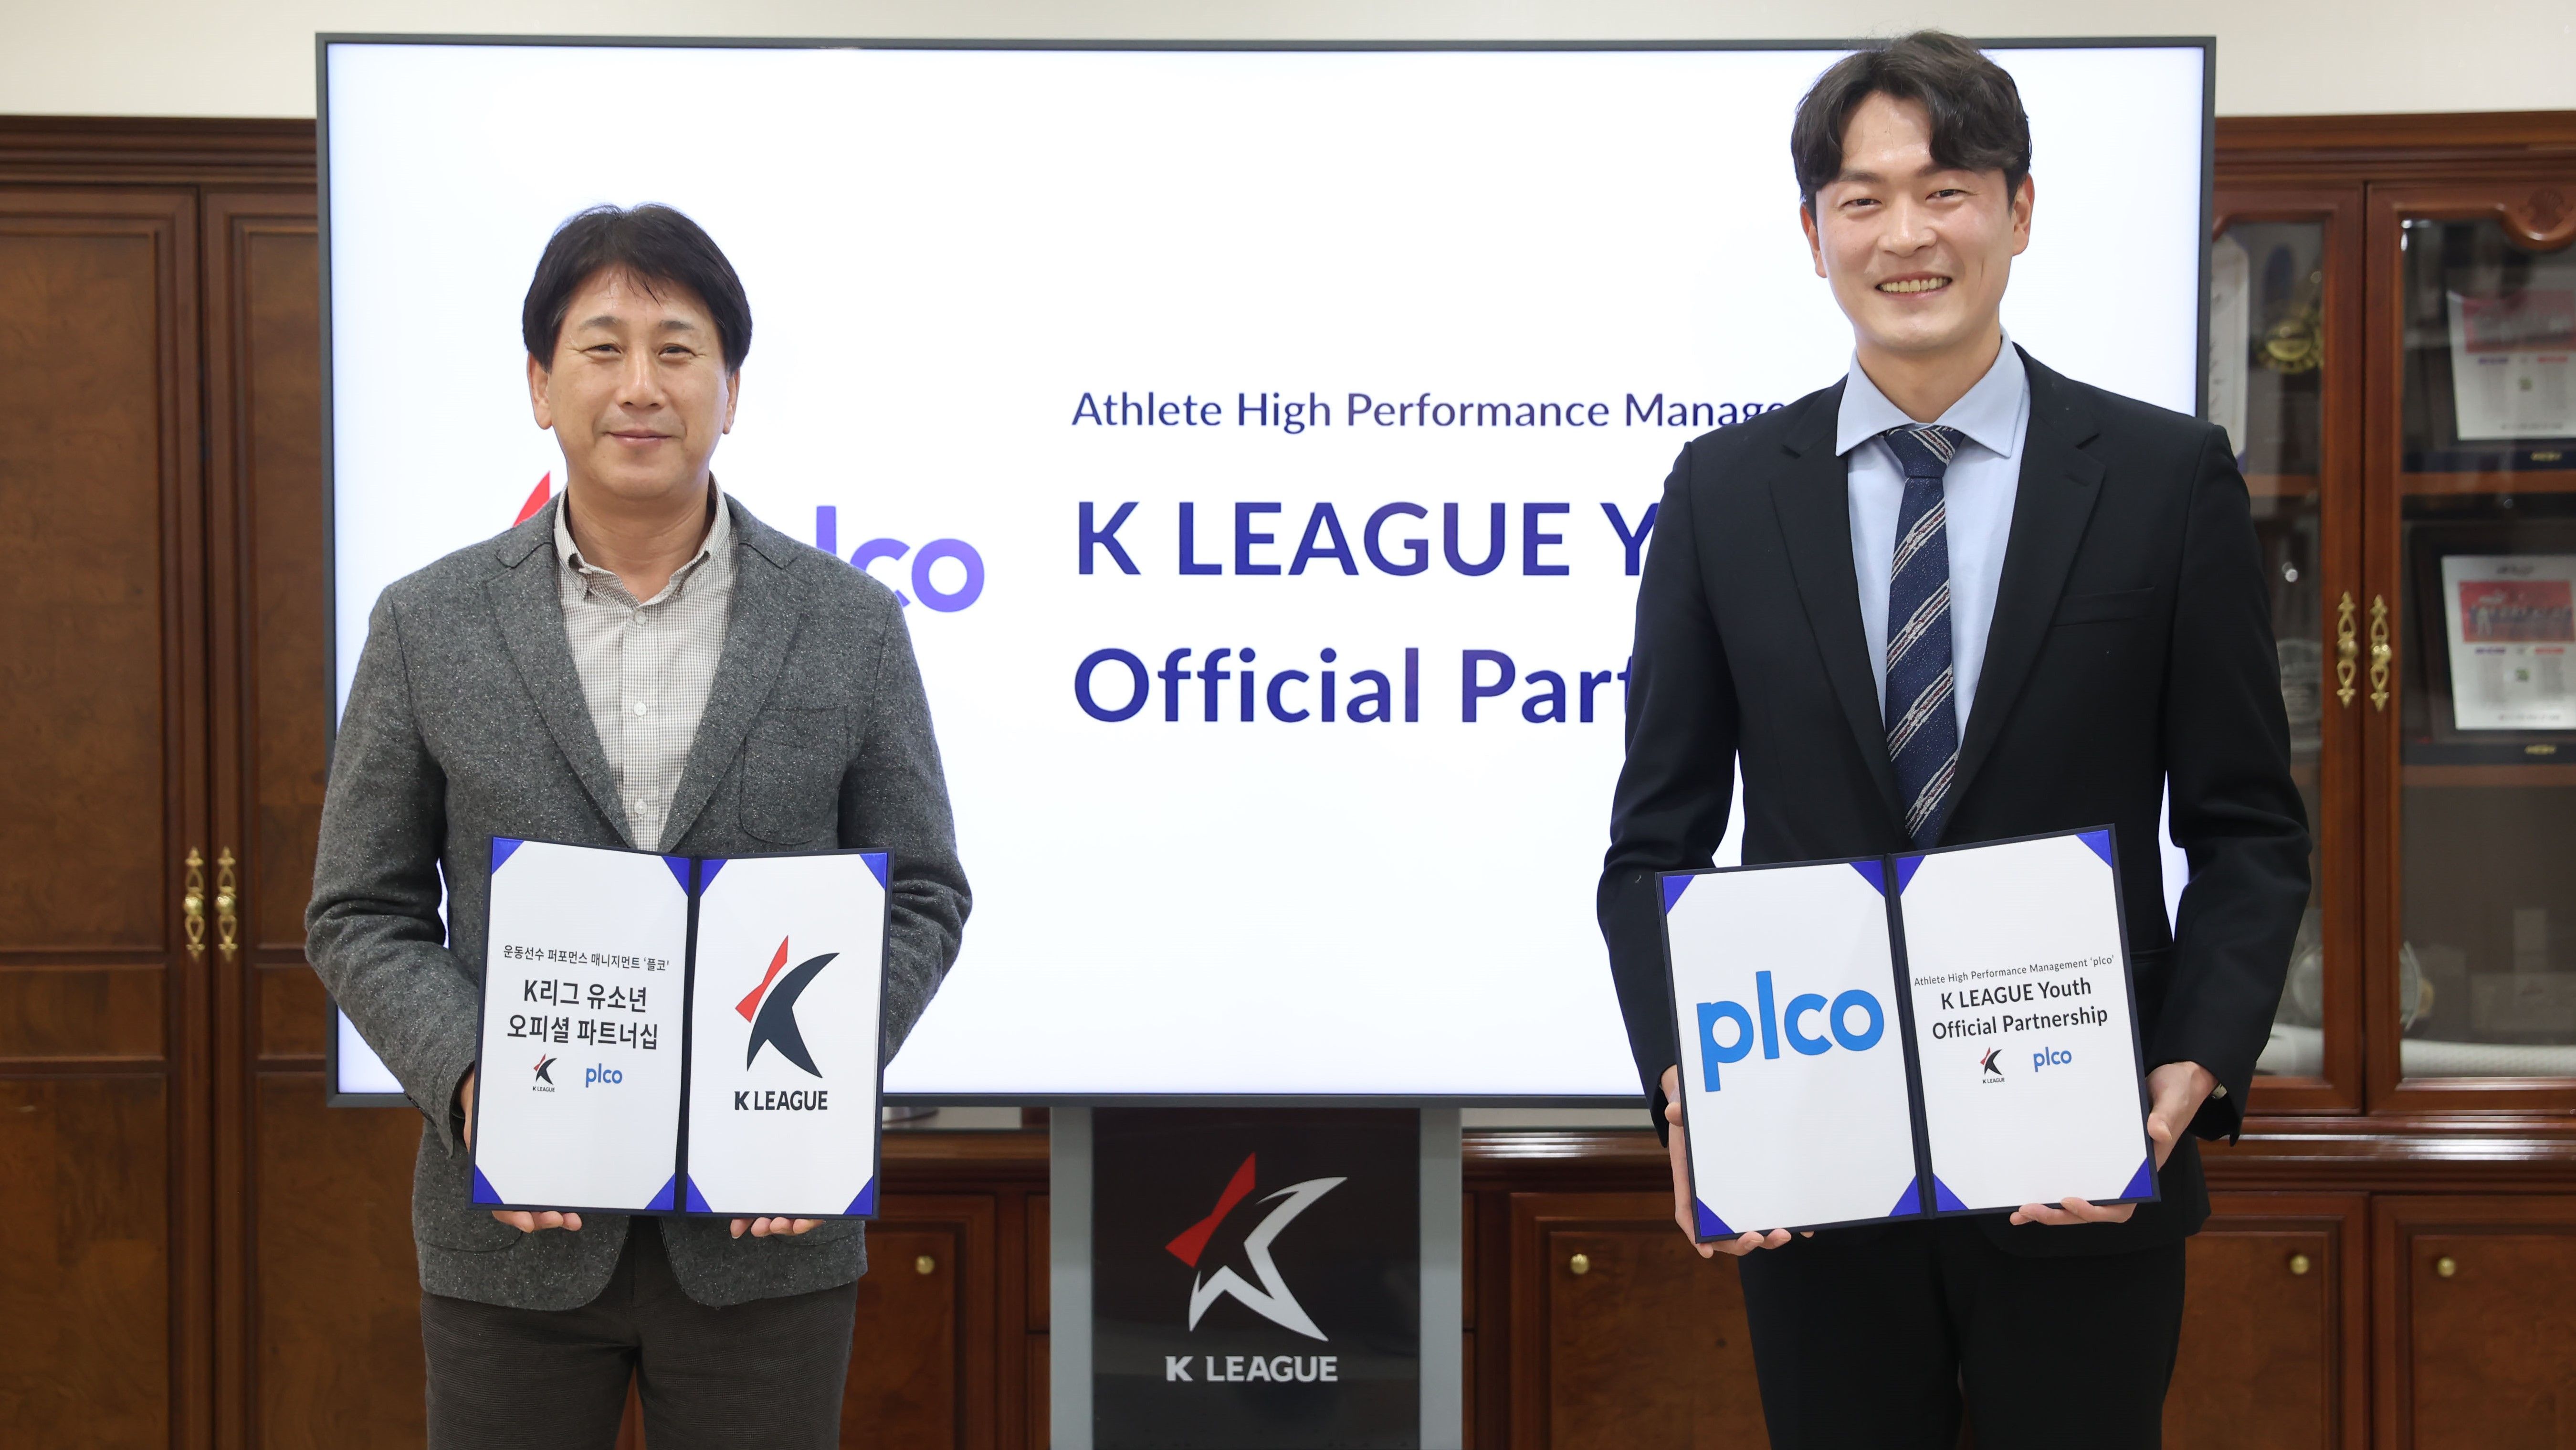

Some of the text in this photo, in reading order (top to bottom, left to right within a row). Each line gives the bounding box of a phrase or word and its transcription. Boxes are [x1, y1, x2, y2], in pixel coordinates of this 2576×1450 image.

[1072, 392, 1222, 426] Athlete
[1238, 392, 1331, 435] High
[1348, 392, 1609, 427] Performance
[1078, 501, 1142, 576] K
[1178, 501, 1570, 577] LEAGUE
[1074, 646, 1419, 724] Official
[503, 945, 545, 961] 운동선수
[547, 949, 588, 964] 퍼포먼스
[591, 953, 640, 969] 매니지먼트
[1914, 973, 1945, 986] Athlete
[1948, 971, 1968, 984] High
[1970, 966, 2027, 980] Performance
[2029, 958, 2088, 974] Management
[524, 979, 647, 1013] K리그 유소년
[1941, 977, 2092, 1010] K LEAGUE Youth
[507, 1014, 658, 1050] 오피셜 파트너십
[1696, 970, 1885, 1093] plco
[1932, 1005, 2108, 1040] Official Partnership
[585, 1063, 623, 1088] plco
[2033, 1046, 2072, 1073] plco
[734, 1090, 829, 1111] K LEAGUE
[1165, 1355, 1338, 1382] K LEAGUE
